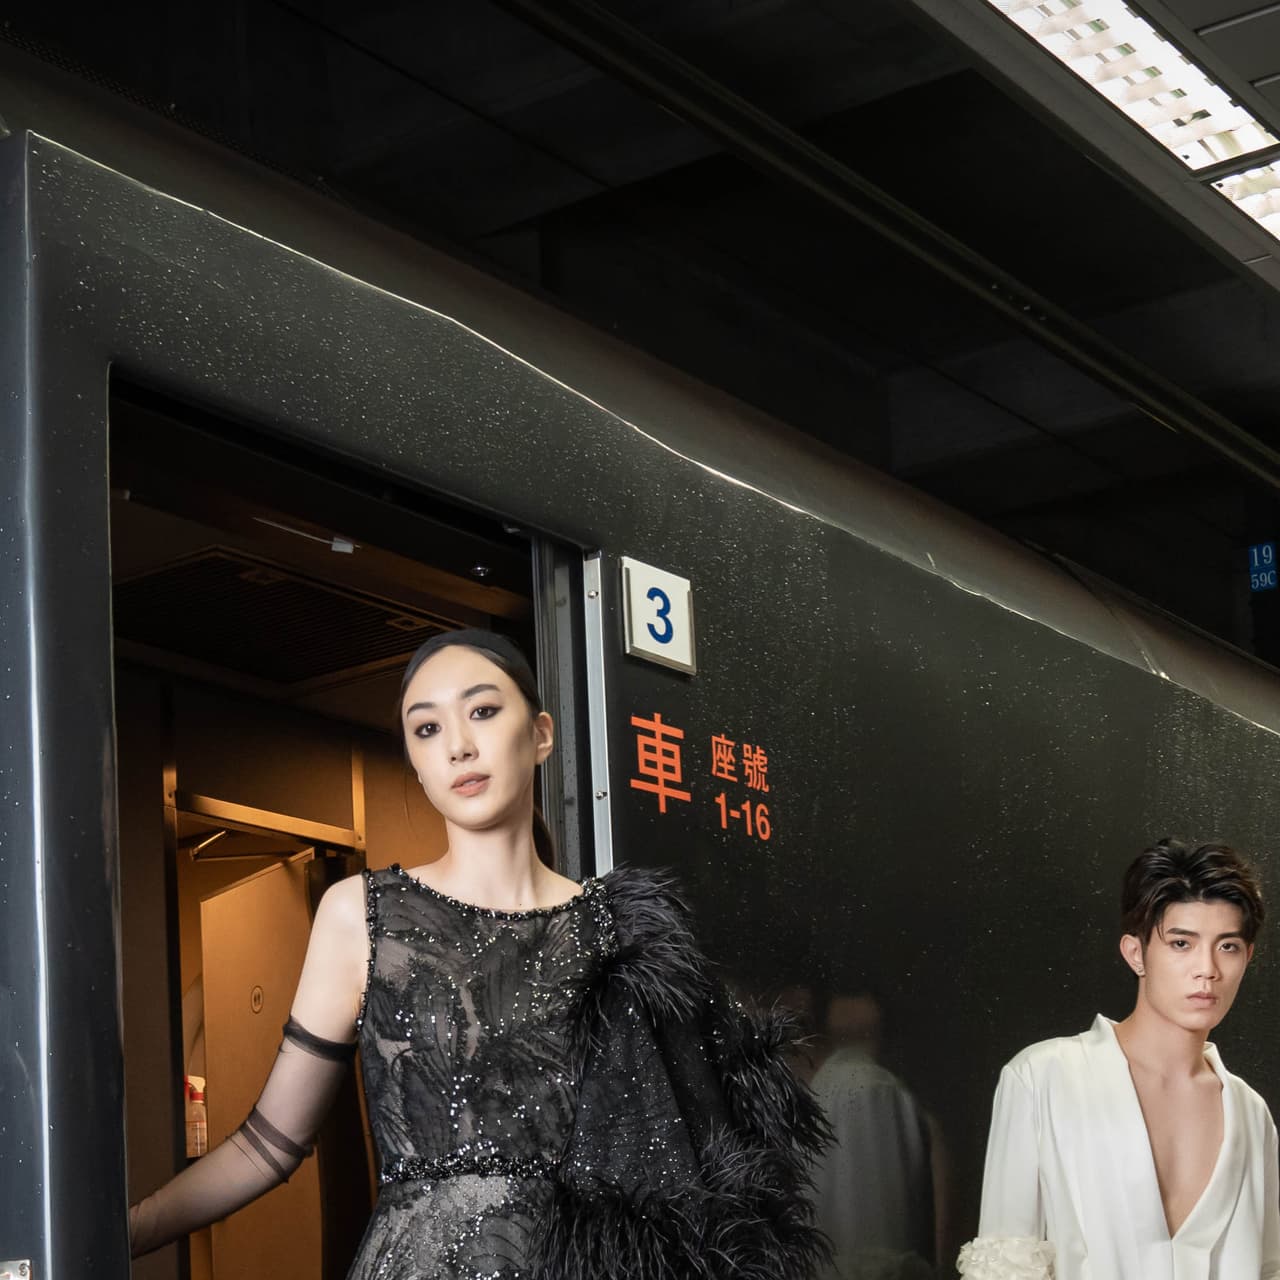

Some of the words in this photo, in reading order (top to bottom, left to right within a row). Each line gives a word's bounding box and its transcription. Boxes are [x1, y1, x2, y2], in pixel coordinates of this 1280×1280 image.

[1250, 570, 1276, 590] 59C
[1252, 544, 1273, 567] 19
[646, 586, 674, 645] 3
[629, 712, 692, 814] 車
[711, 733, 770, 793] 座號
[714, 792, 771, 841] 1-16
